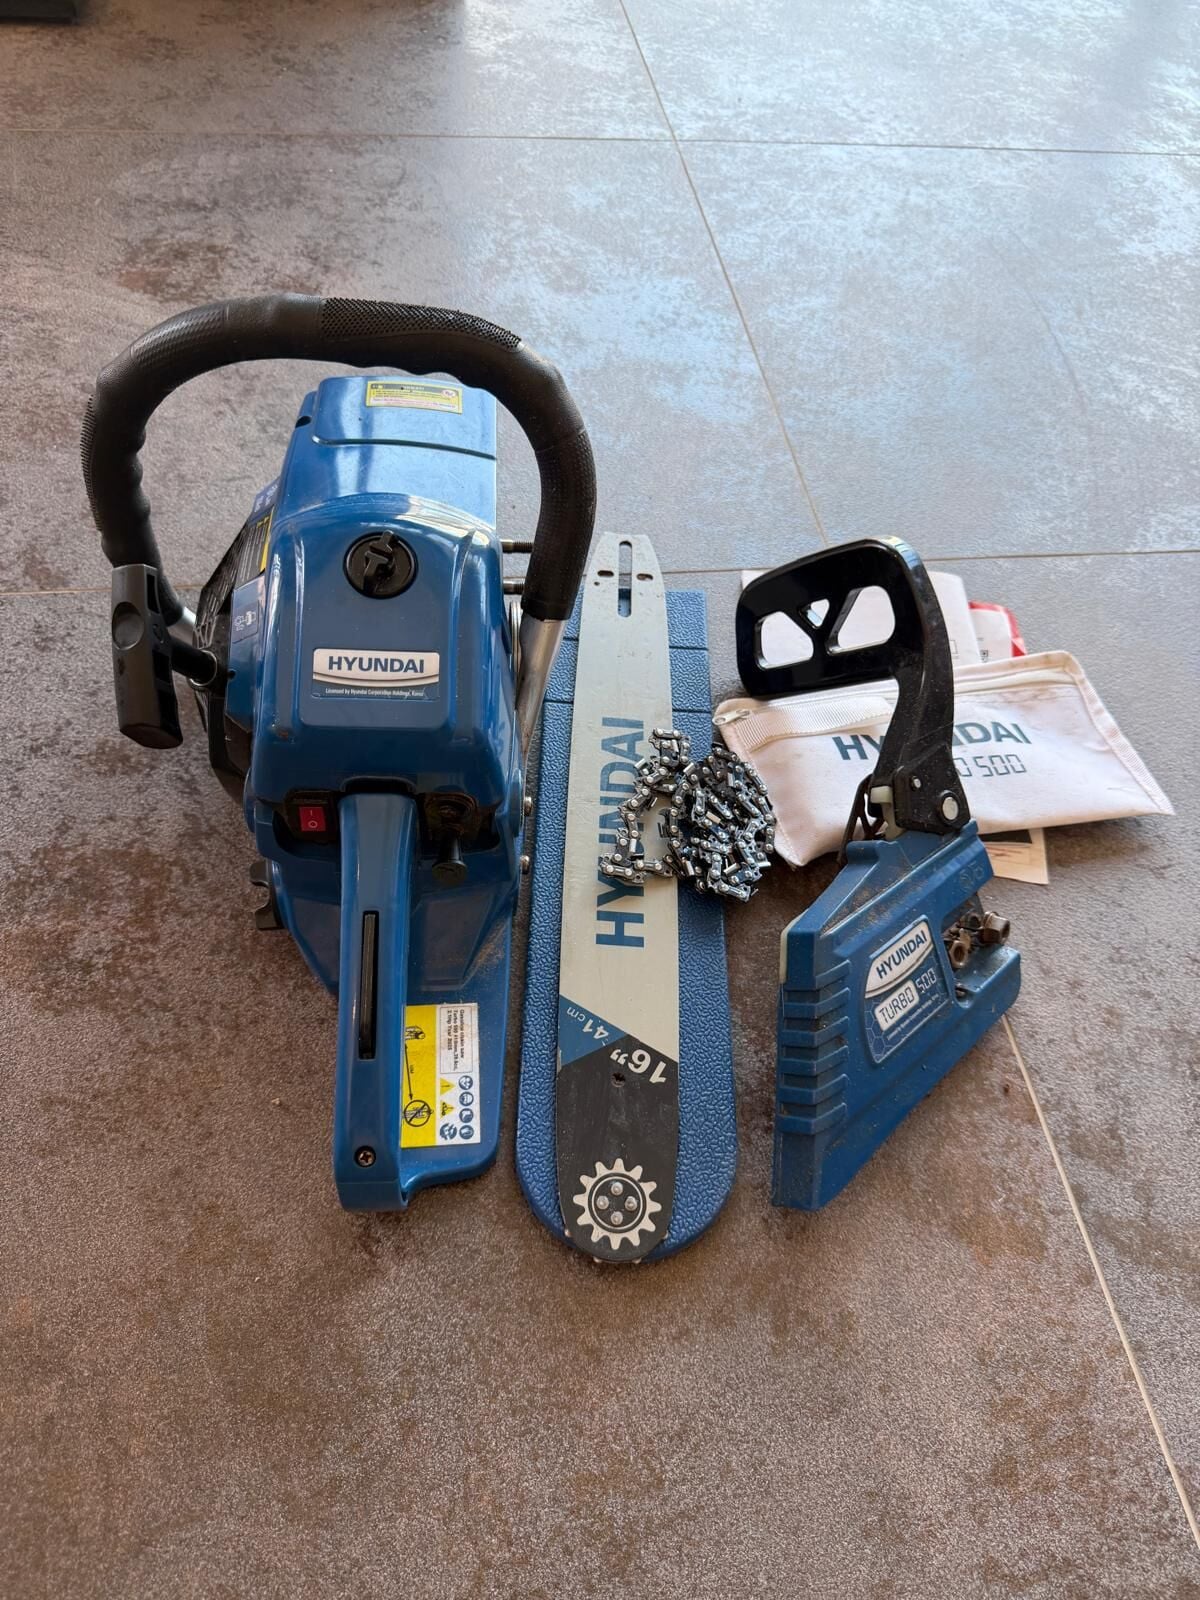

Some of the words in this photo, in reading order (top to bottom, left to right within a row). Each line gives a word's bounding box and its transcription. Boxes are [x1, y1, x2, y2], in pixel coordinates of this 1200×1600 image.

[328, 656, 424, 673] HYUNDAI
[832, 721, 1032, 761] HDAI
[974, 753, 1027, 778] 500
[876, 929, 927, 979] HYUNDAI
[879, 986, 915, 1024] TURBO
[915, 967, 937, 993] 500
